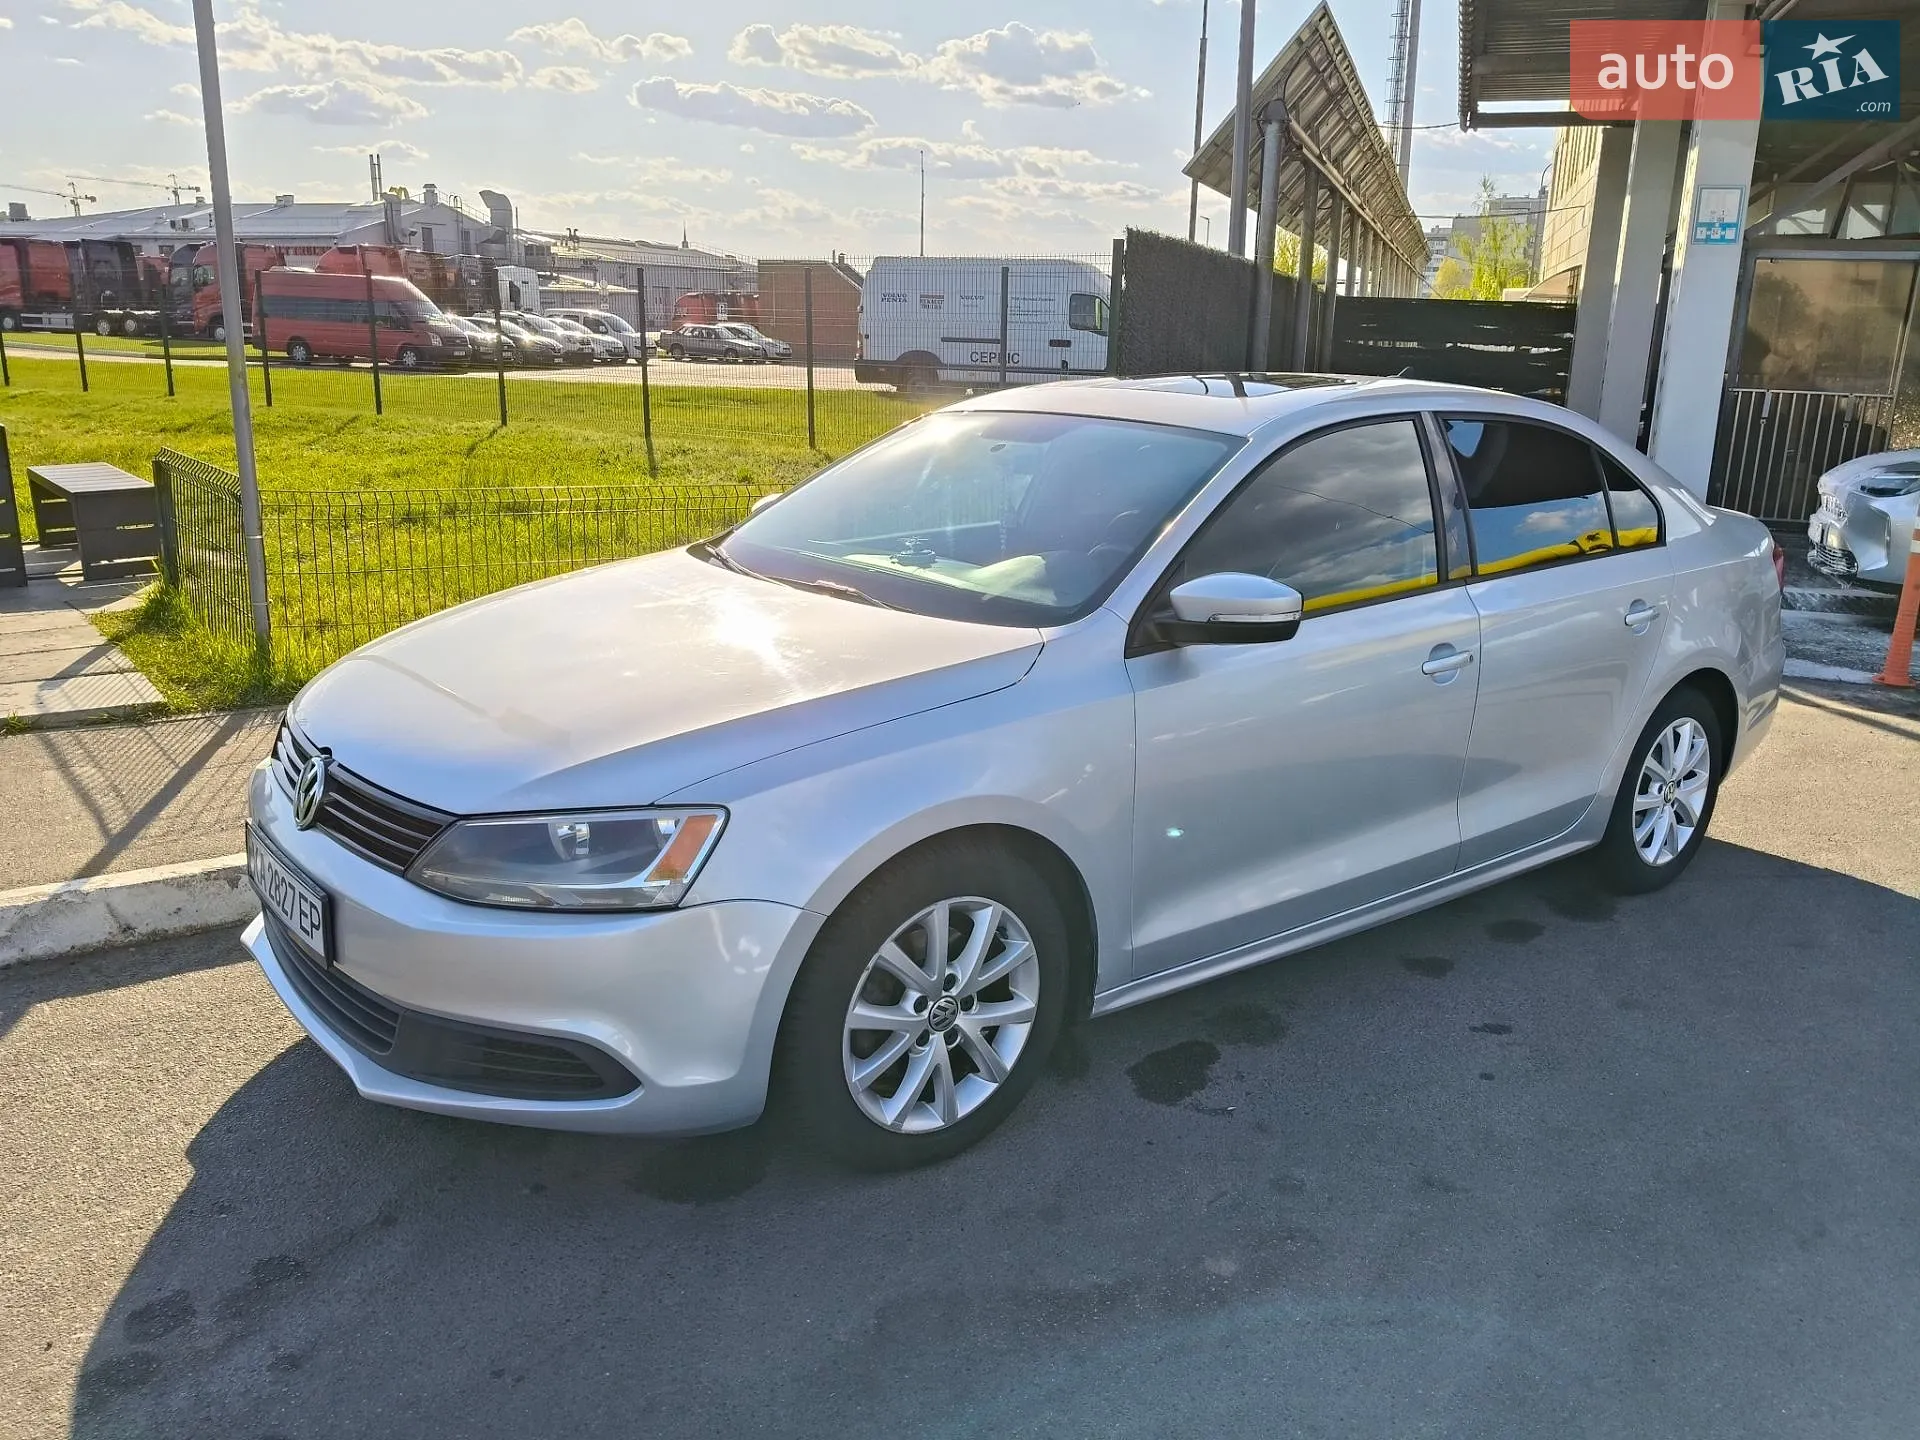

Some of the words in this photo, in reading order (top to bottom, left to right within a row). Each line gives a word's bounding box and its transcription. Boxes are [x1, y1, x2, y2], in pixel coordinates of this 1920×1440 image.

[970, 352, 1020, 364] СЕРІС
[267, 861, 296, 921] 2827
[298, 891, 321, 940] EP
